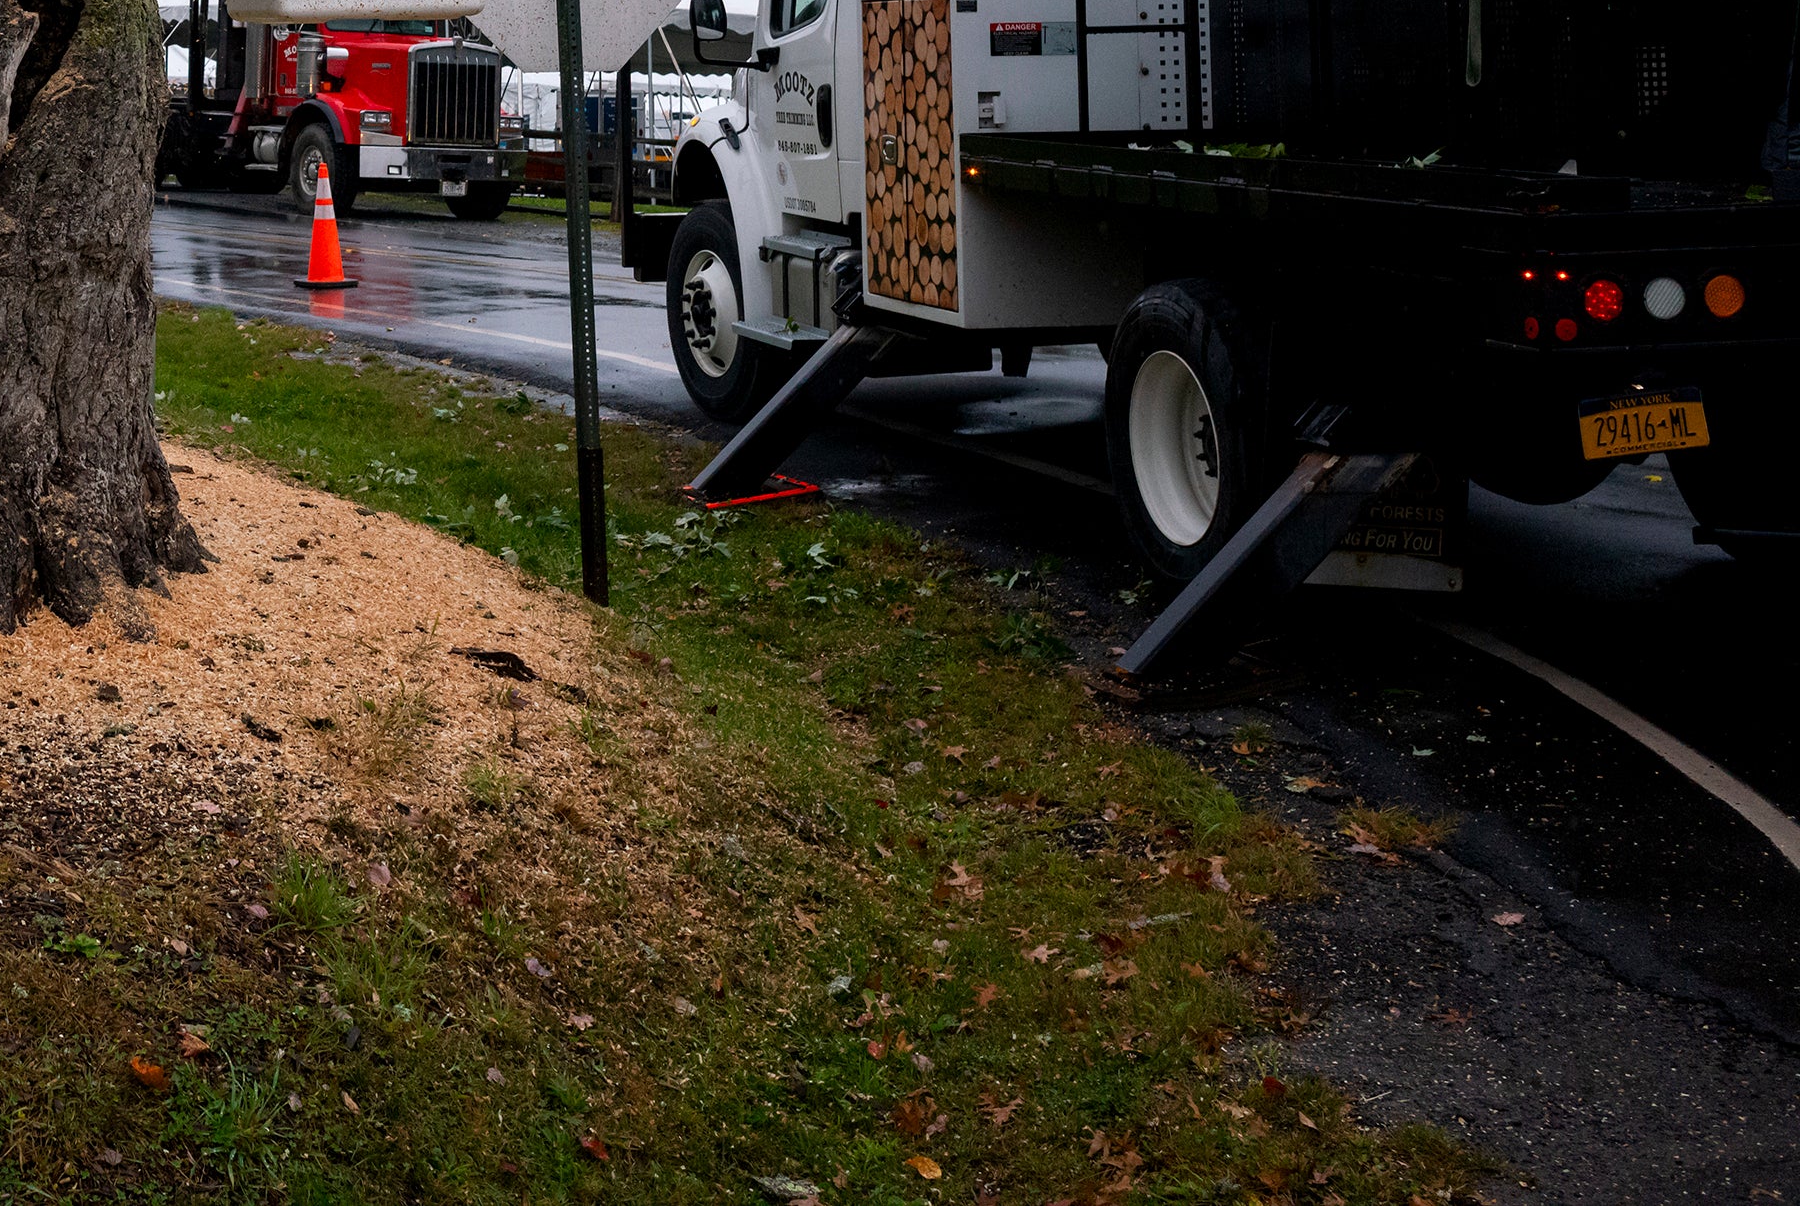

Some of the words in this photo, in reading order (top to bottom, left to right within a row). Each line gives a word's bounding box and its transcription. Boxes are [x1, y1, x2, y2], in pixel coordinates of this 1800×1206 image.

[1005, 23, 1037, 31] DANGER
[774, 71, 815, 107] MOOTZ
[1609, 398, 1637, 410] NEW
[1638, 393, 1672, 406] YORK
[1613, 441, 1678, 453] COMMERCIAL
[1369, 505, 1445, 522] FORESTS
